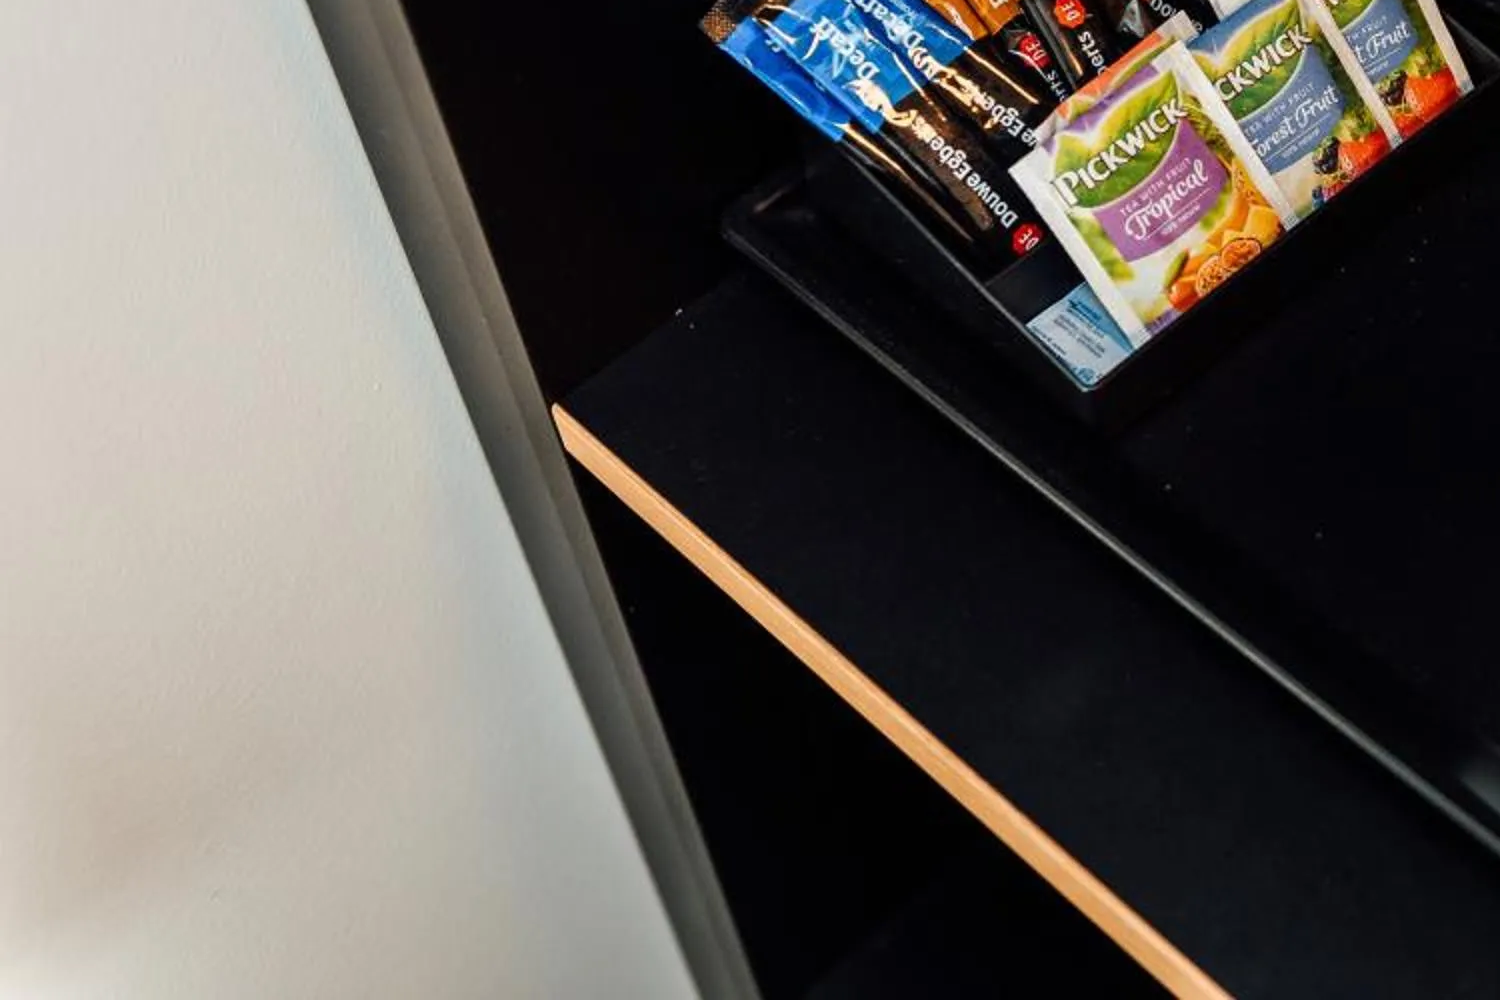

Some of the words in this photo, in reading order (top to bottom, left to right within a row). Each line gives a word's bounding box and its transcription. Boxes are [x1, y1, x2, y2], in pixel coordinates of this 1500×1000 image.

[1079, 31, 1106, 73] erts
[1214, 24, 1312, 102] CKWICK
[1366, 22, 1411, 56] Fruit
[1295, 85, 1339, 125] Fruit
[1053, 97, 1187, 206] PICKWICK
[966, 175, 1018, 228] Douwe
[1125, 159, 1208, 240] Tropical
